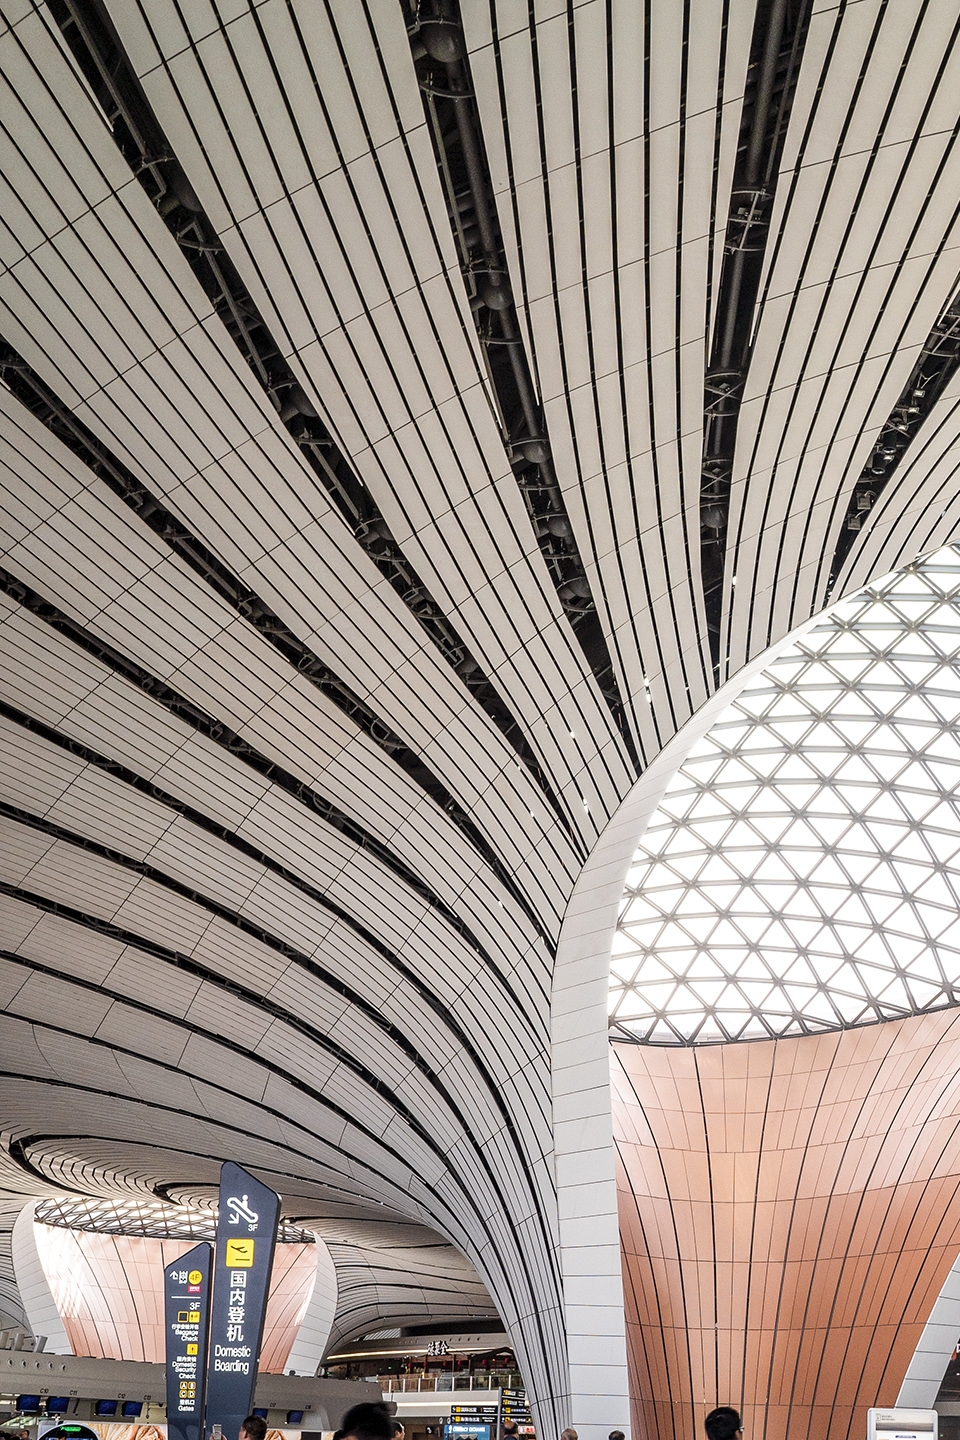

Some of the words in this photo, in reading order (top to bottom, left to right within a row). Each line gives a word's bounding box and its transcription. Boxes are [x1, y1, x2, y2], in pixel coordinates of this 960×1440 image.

[247, 1223, 258, 1232] 3F
[189, 1302, 201, 1310] 3F
[226, 1270, 247, 1342] 国内登机
[214, 1344, 251, 1358] Domestic
[214, 1359, 250, 1375] Boarding
